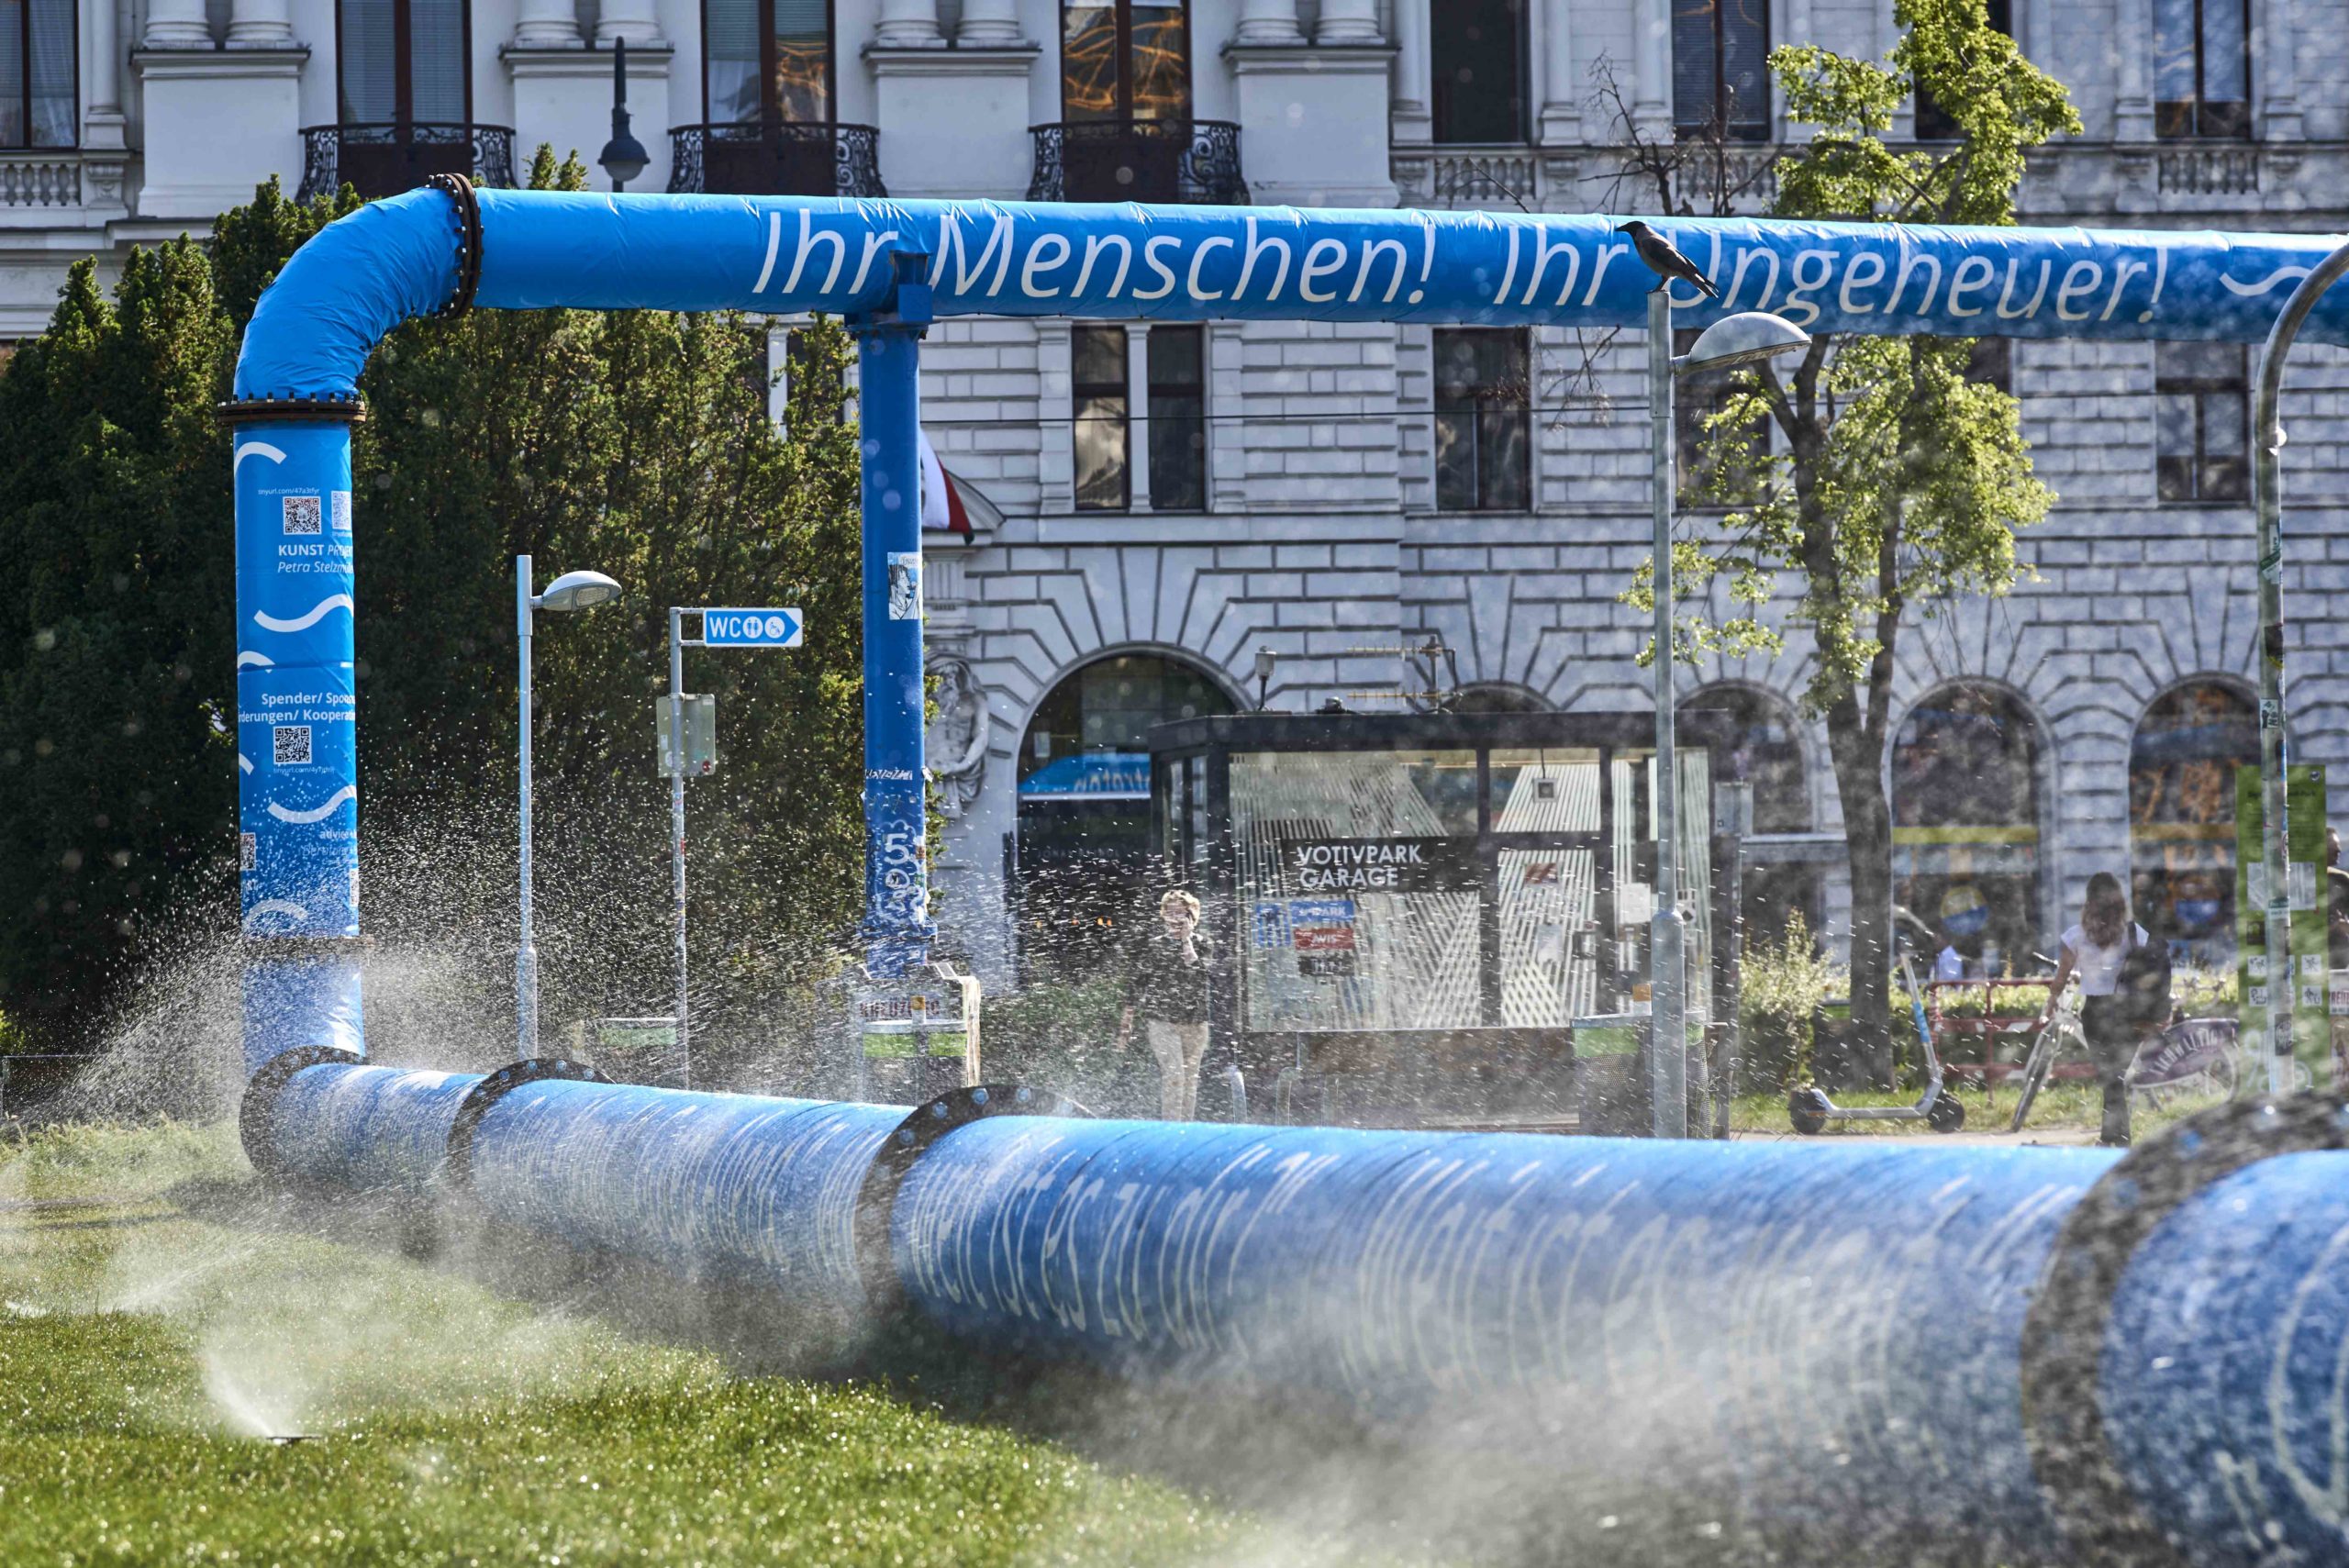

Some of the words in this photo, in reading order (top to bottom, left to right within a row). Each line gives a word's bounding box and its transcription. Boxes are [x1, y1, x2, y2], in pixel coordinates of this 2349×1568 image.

[751, 209, 897, 294] Ihr
[929, 215, 1436, 305] Menschen!
[1493, 224, 1629, 308] Ihr
[278, 544, 324, 556] KUNST
[277, 561, 310, 573] Petra
[709, 617, 741, 638] WC
[262, 692, 323, 708] Spender/
[1297, 844, 1422, 865] VOTIVPARK
[1299, 867, 1398, 888] GARAGE
